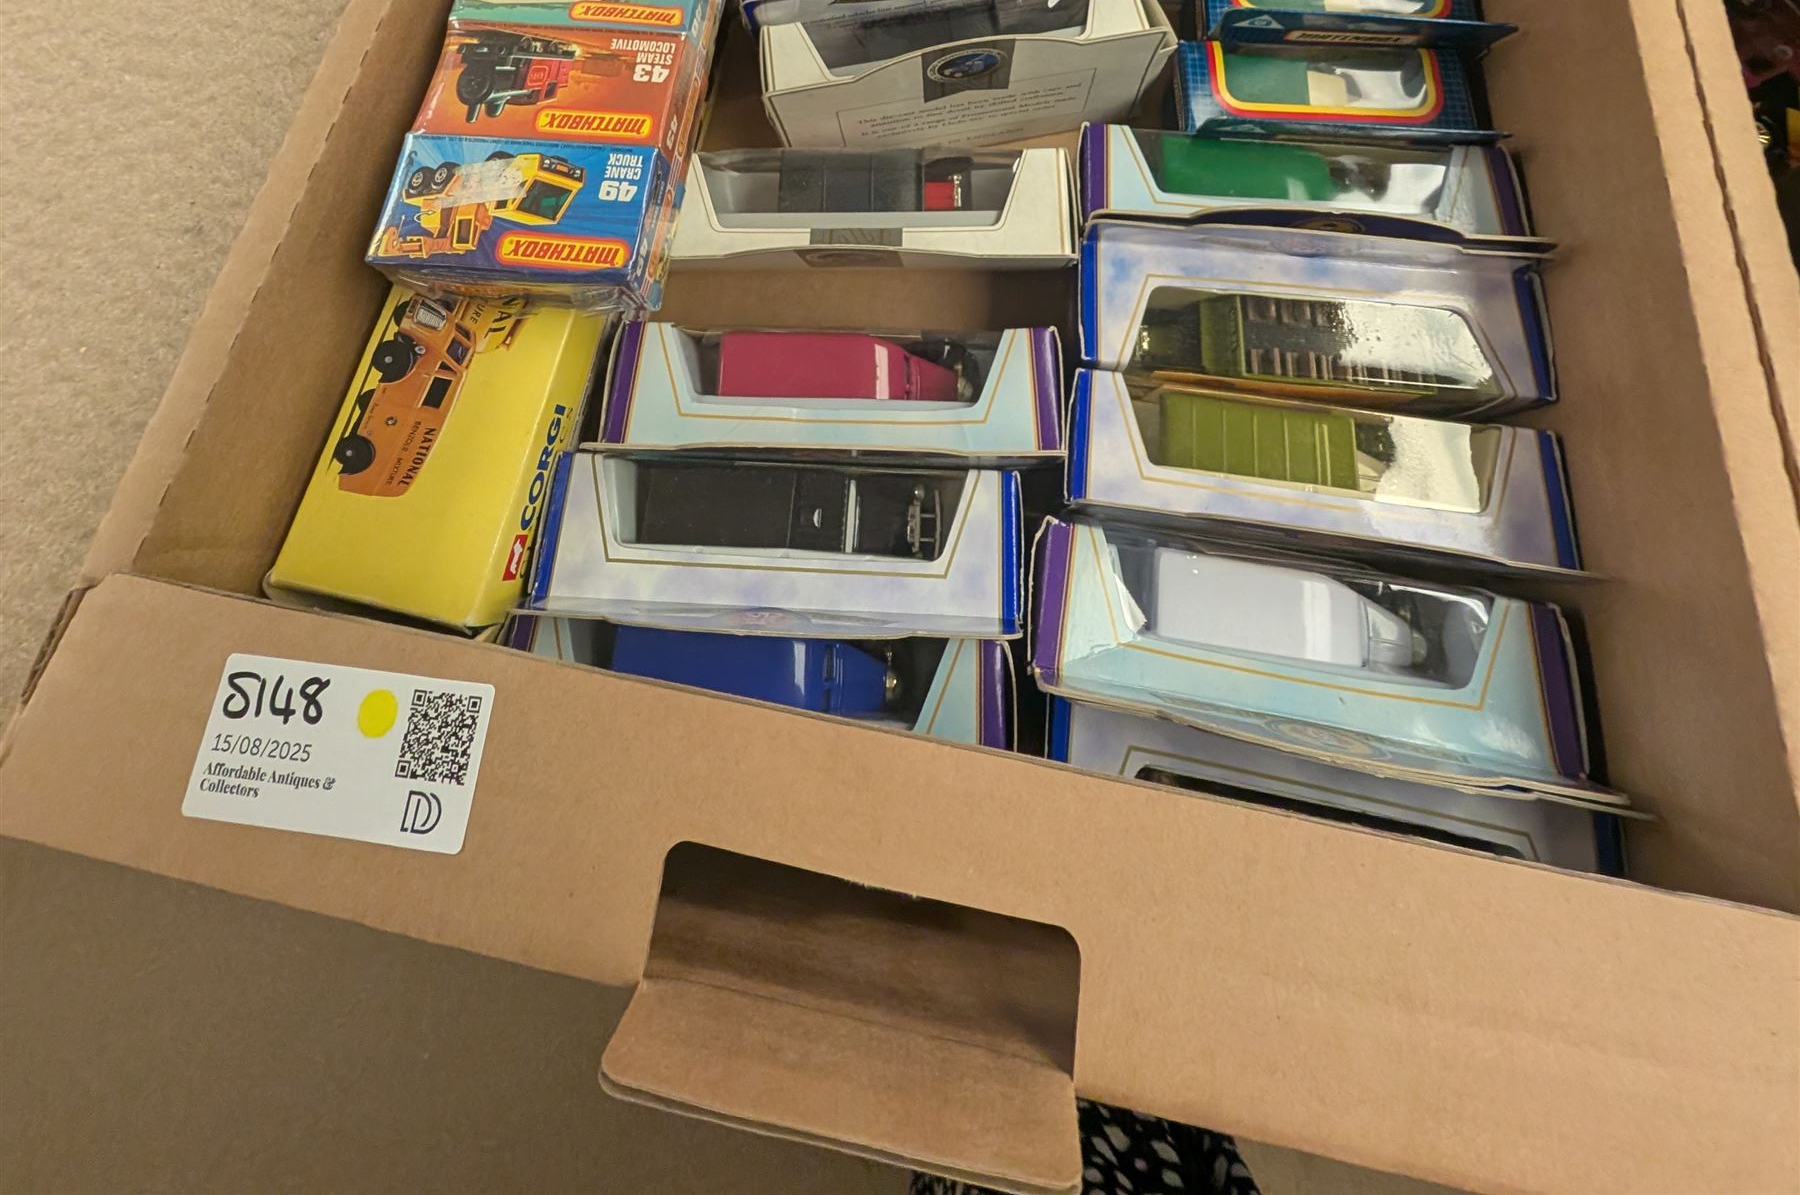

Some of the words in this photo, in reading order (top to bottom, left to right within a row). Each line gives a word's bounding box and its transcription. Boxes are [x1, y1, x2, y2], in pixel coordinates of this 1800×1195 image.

[580, 5, 679, 24] MATCHBOX
[610, 38, 676, 54] LOCOMOTIVE
[636, 52, 673, 65] STEAM
[633, 64, 670, 83] 43
[541, 113, 648, 135] MATCHBOX
[607, 153, 643, 167] TRUCK
[604, 166, 641, 180] CRANE
[598, 180, 638, 202] 49
[506, 239, 621, 267] MATCHBOX
[399, 427, 437, 486] NATIONAL
[520, 404, 566, 531] CORGI
[211, 733, 312, 763] 15/08/2025
[203, 762, 267, 782] Affordable
[269, 771, 320, 789] Antiques
[323, 777, 336, 791] &
[199, 778, 259, 798] Collectors
